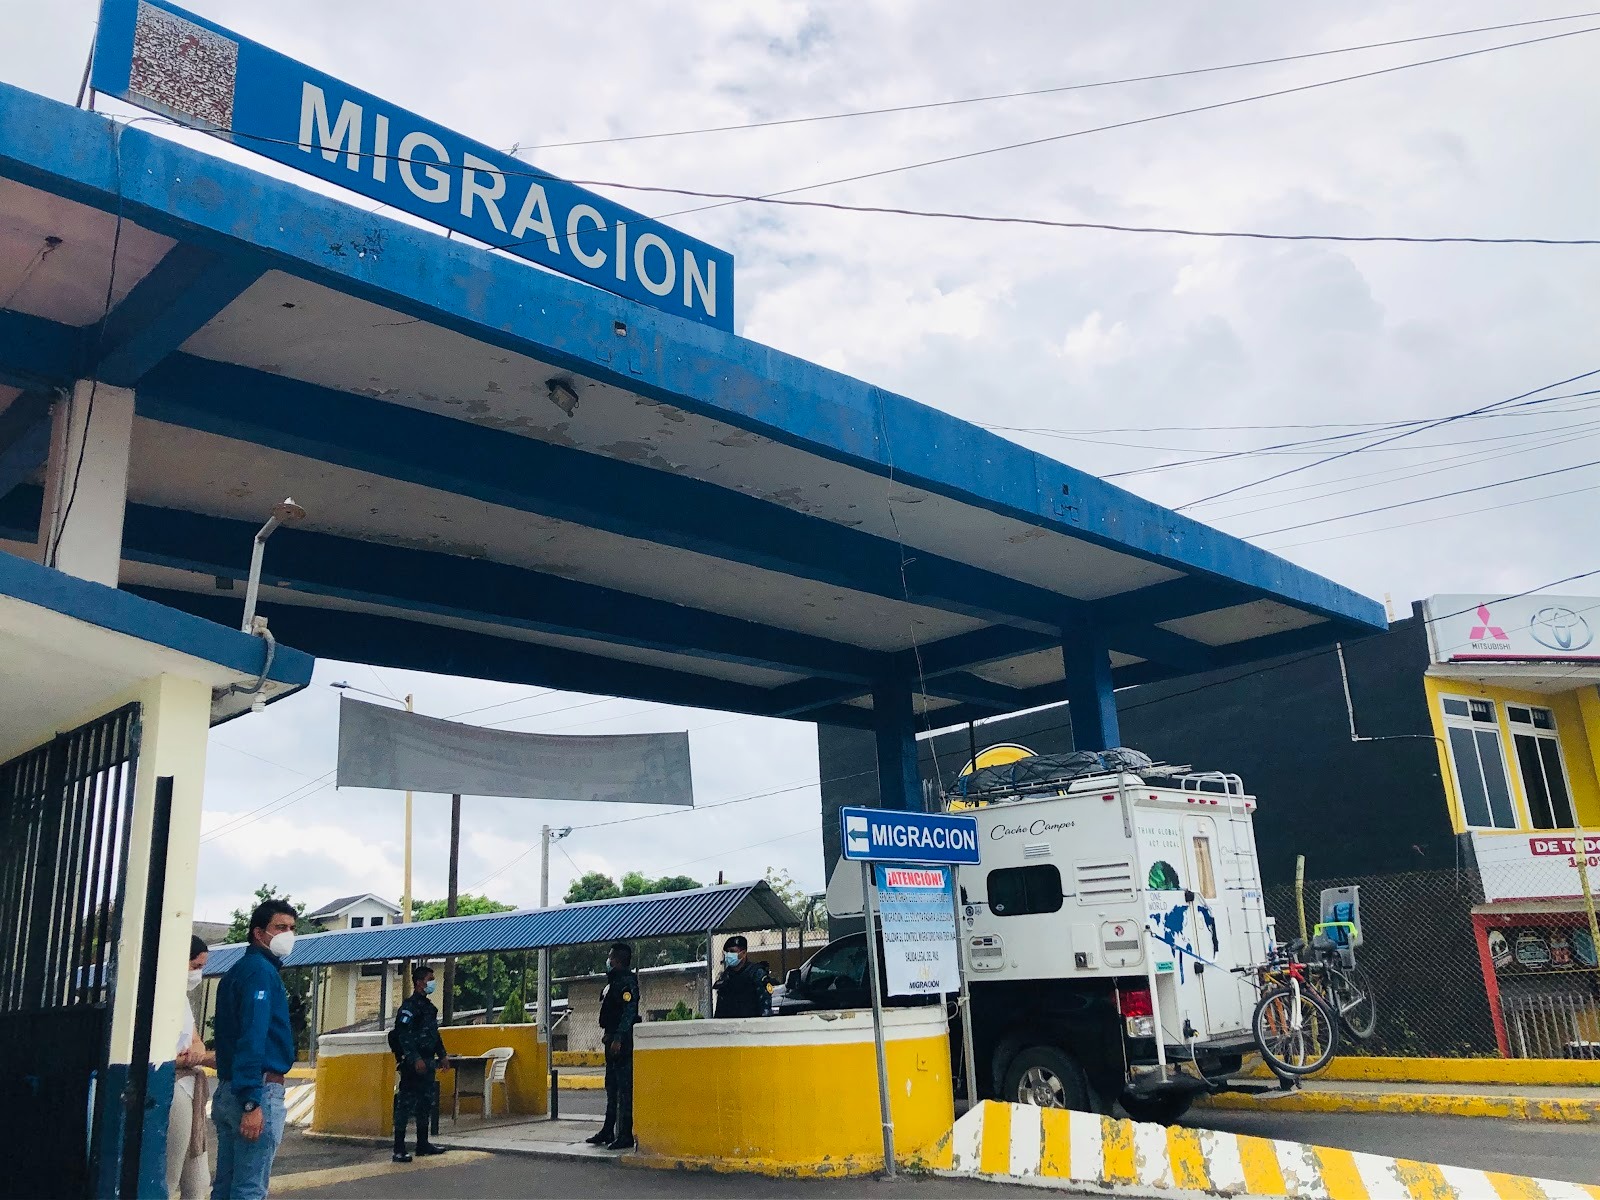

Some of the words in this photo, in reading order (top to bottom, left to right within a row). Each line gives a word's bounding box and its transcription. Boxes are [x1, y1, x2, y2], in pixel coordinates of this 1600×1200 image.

[298, 81, 718, 318] MIGRACION
[1472, 642, 1511, 650] MITSUBISHI
[1029, 819, 1075, 836] Camper
[1137, 826, 1155, 835] THINK
[1157, 828, 1178, 836] GLOBAL
[871, 823, 976, 850] MIGRACION
[1149, 839, 1159, 847] ACT
[1162, 840, 1180, 848] LOCAL
[1534, 840, 1560, 853] DE
[887, 870, 943, 886] ¡ATENCIÓN!
[1150, 892, 1162, 901] ONE
[1148, 901, 1168, 911] WORLD
